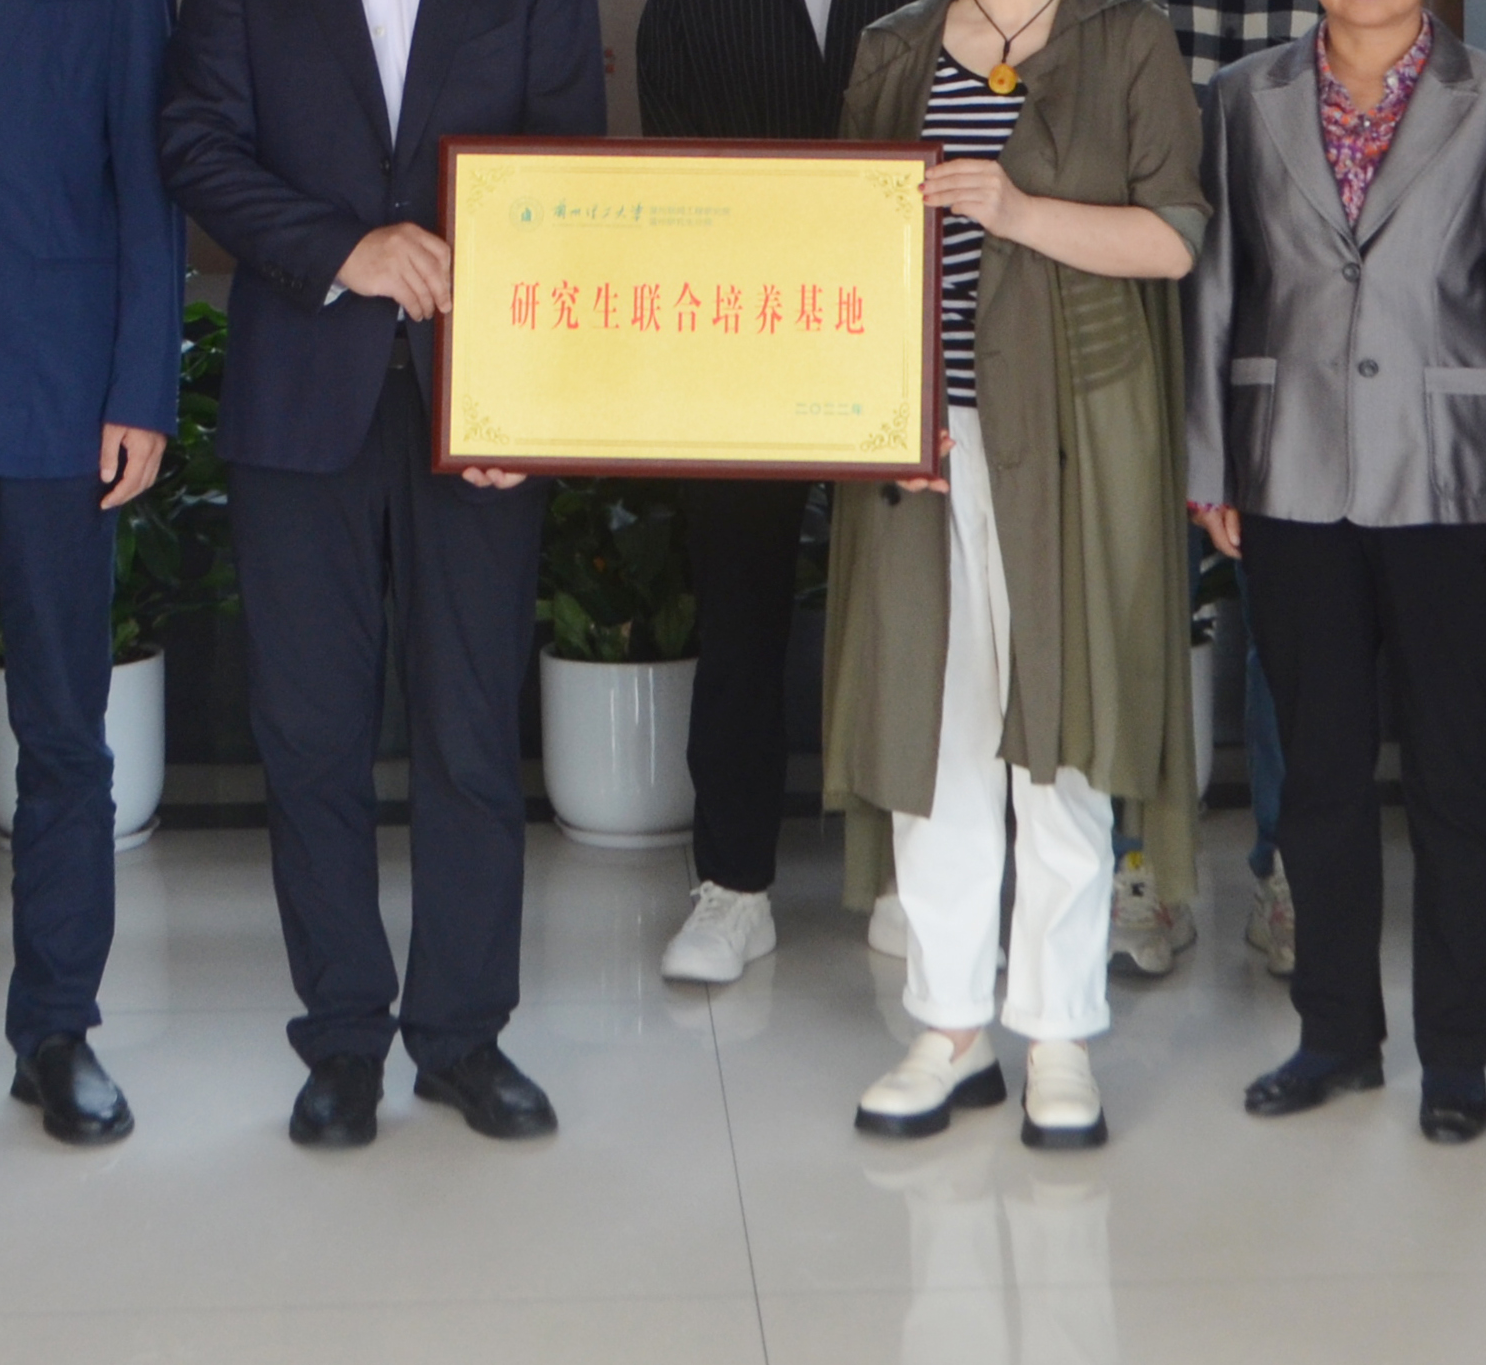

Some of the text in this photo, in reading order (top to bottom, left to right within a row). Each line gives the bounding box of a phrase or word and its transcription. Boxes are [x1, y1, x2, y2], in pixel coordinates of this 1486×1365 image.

[509, 279, 866, 336] 研究生联合培养基地
